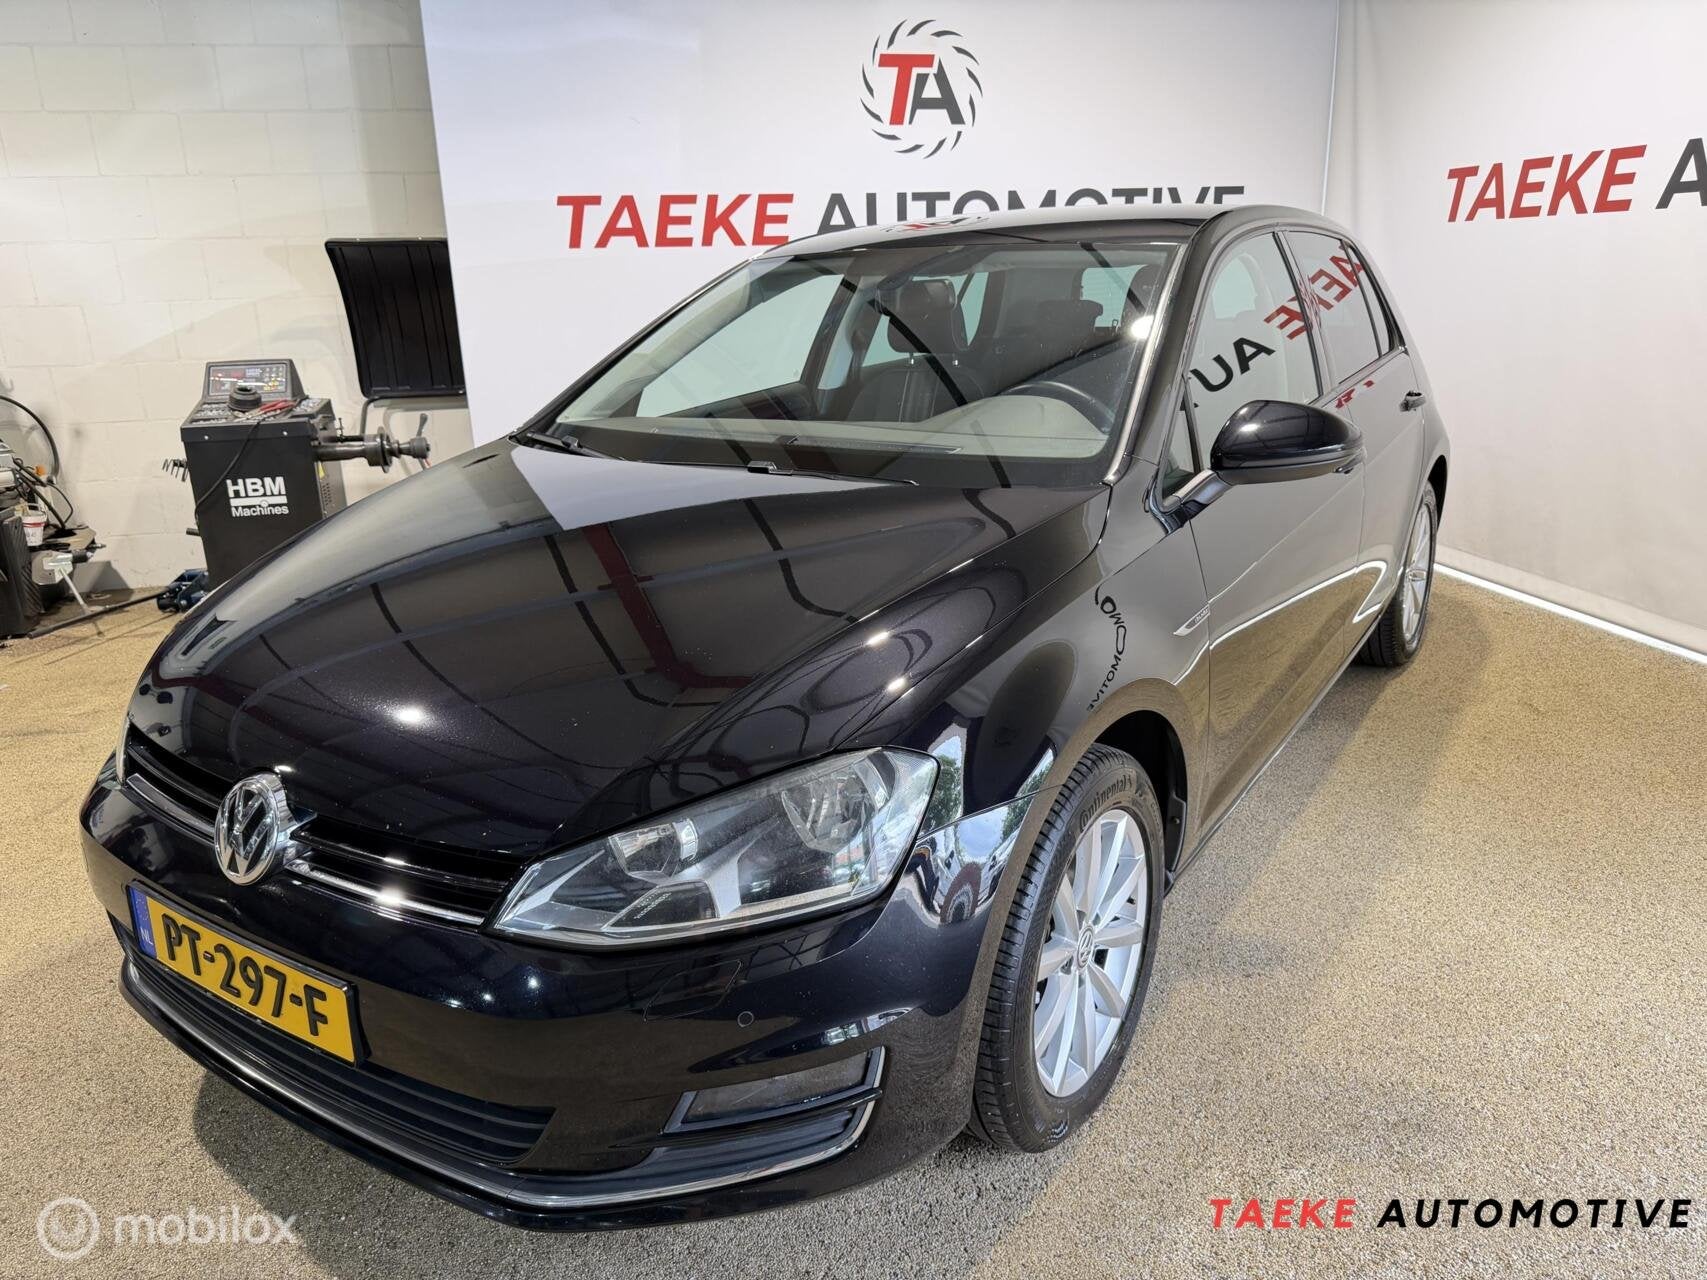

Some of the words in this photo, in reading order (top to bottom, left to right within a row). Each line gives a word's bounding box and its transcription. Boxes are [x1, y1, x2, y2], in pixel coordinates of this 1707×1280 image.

[877, 53, 965, 126] TA
[1447, 144, 1648, 223] TAEKE
[556, 193, 794, 249] TAEKE
[226, 476, 286, 498] HBM
[231, 505, 289, 517] Machines
[161, 913, 329, 1037] PT-297-F
